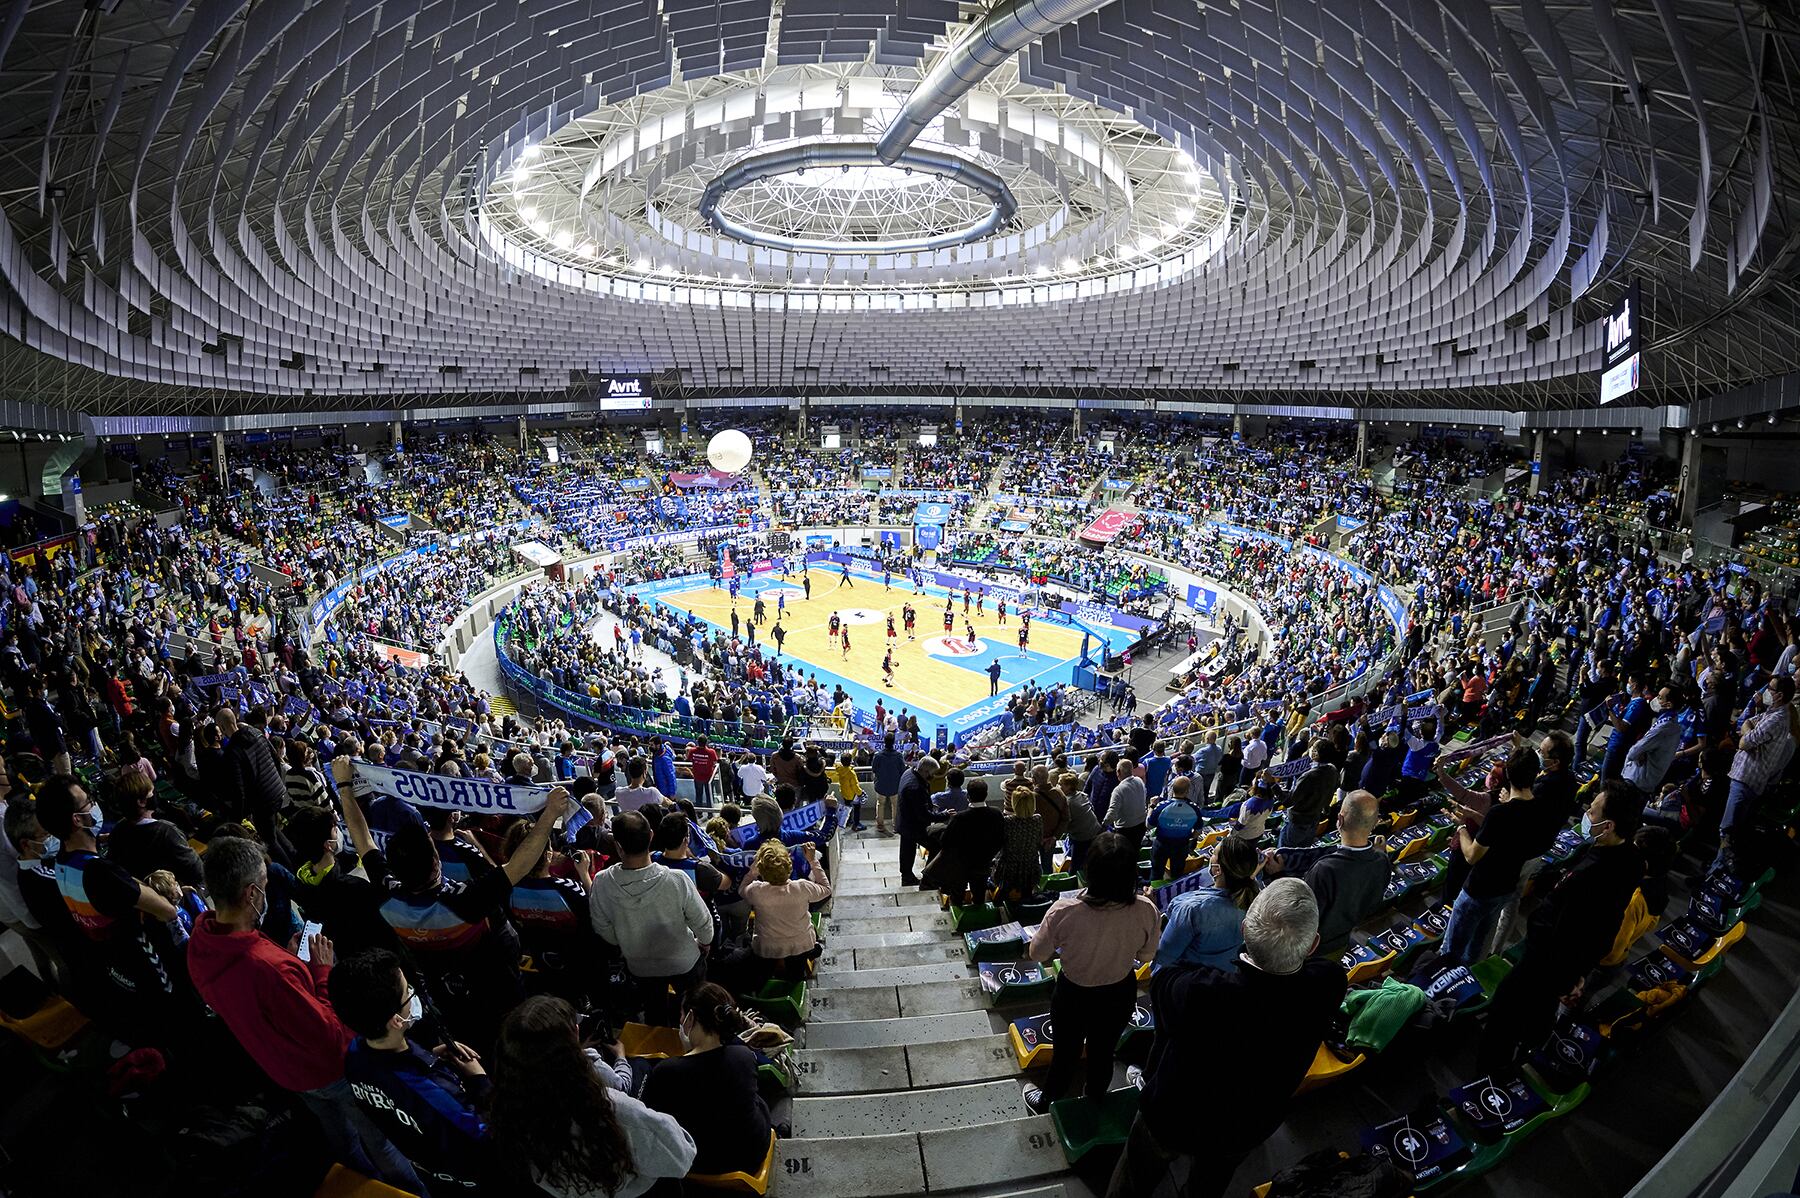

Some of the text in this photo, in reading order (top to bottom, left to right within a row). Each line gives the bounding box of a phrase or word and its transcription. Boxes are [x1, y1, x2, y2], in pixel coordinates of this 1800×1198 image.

[1682, 465, 1688, 477] G
[1076, 610, 1113, 625] 2021/22
[1029, 1131, 1057, 1149] 16
[785, 1157, 811, 1174] 16
